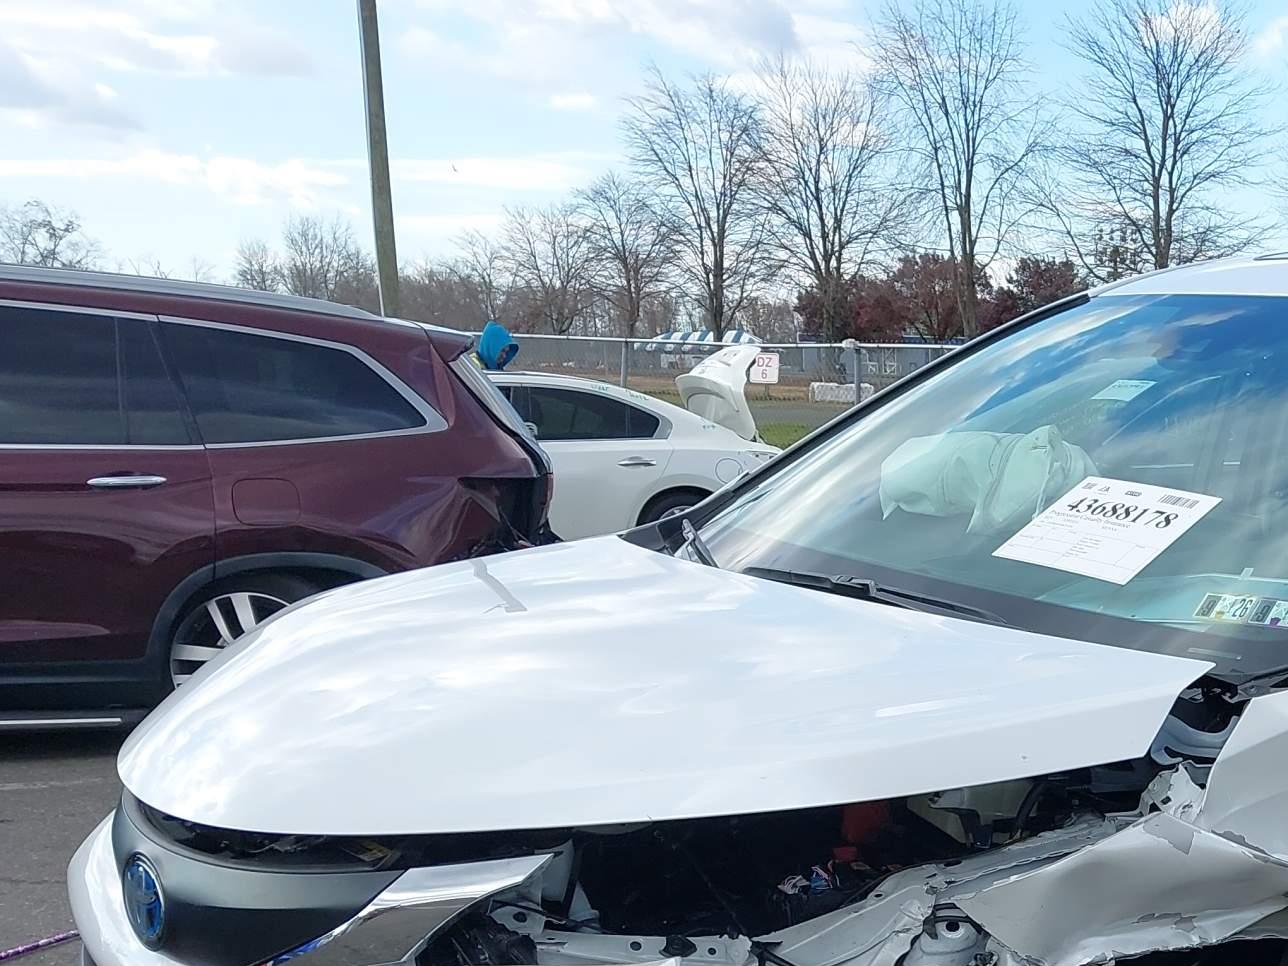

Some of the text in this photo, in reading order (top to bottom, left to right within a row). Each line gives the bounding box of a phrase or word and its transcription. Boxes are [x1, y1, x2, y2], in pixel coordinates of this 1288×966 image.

[757, 356, 773, 368] DZ
[761, 368, 768, 380] 6
[1067, 497, 1179, 529] 43688178
[1231, 598, 1253, 618] 26
